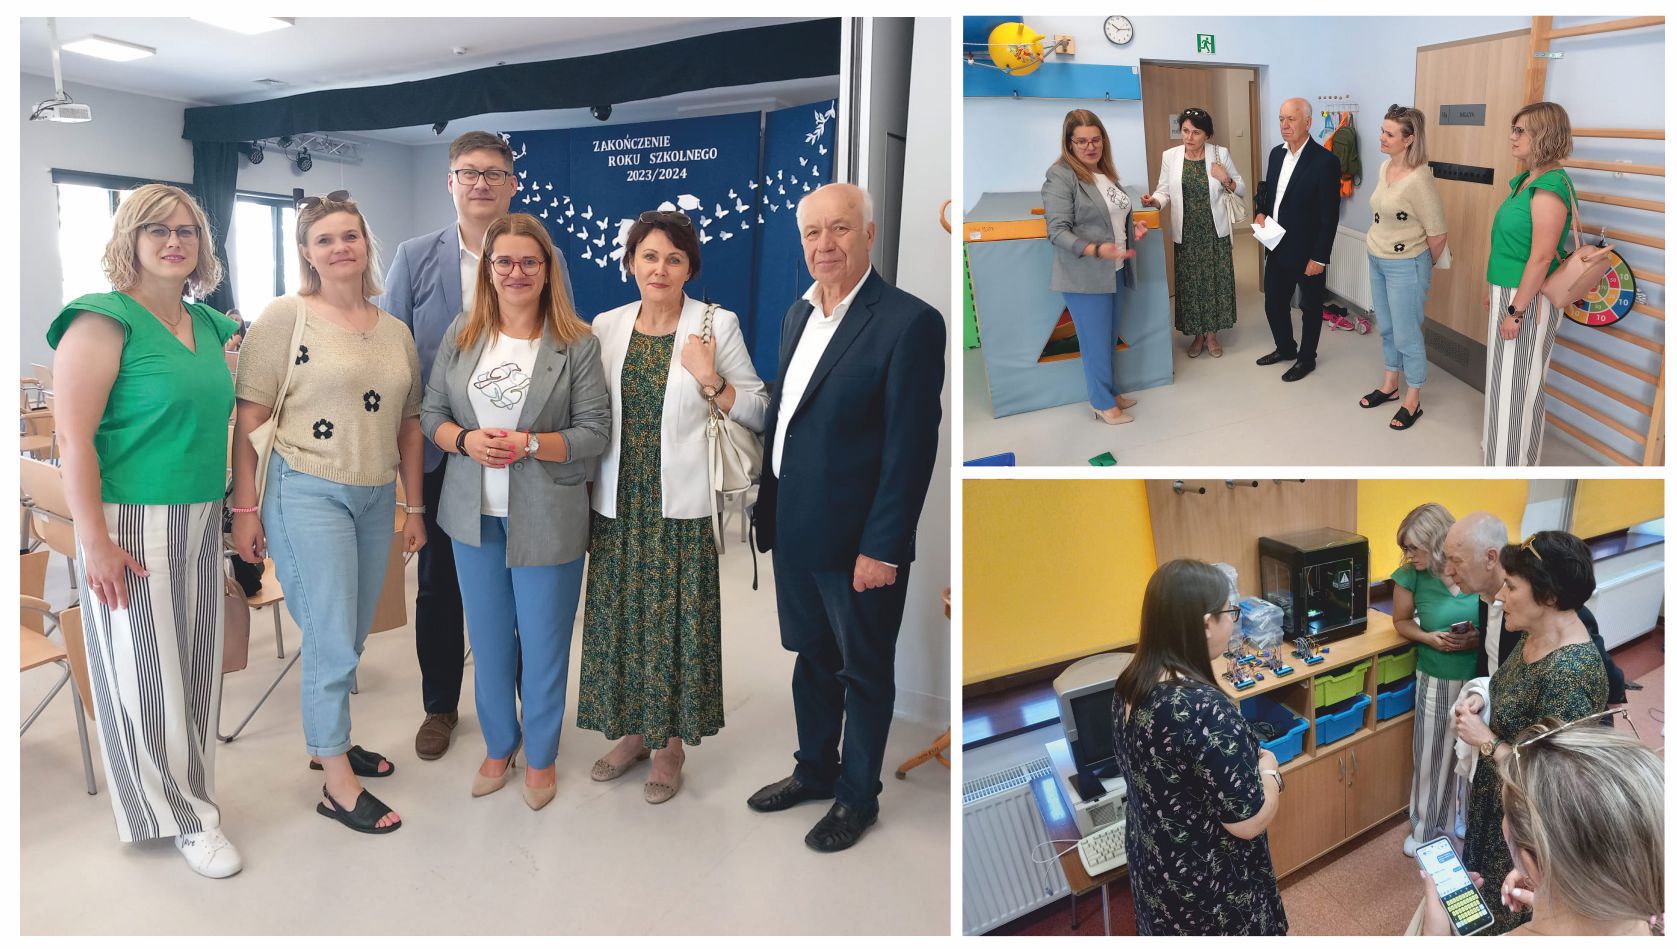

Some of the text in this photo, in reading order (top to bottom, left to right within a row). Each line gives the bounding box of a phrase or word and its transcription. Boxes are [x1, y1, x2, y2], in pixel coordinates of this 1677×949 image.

[592, 134, 671, 152] ZAKOŃCZENIE
[608, 147, 718, 167] ROKU SZKOLNEGO
[626, 168, 688, 182] 2023/2024
[1620, 273, 1629, 281] 10
[1596, 314, 1606, 322] 10
